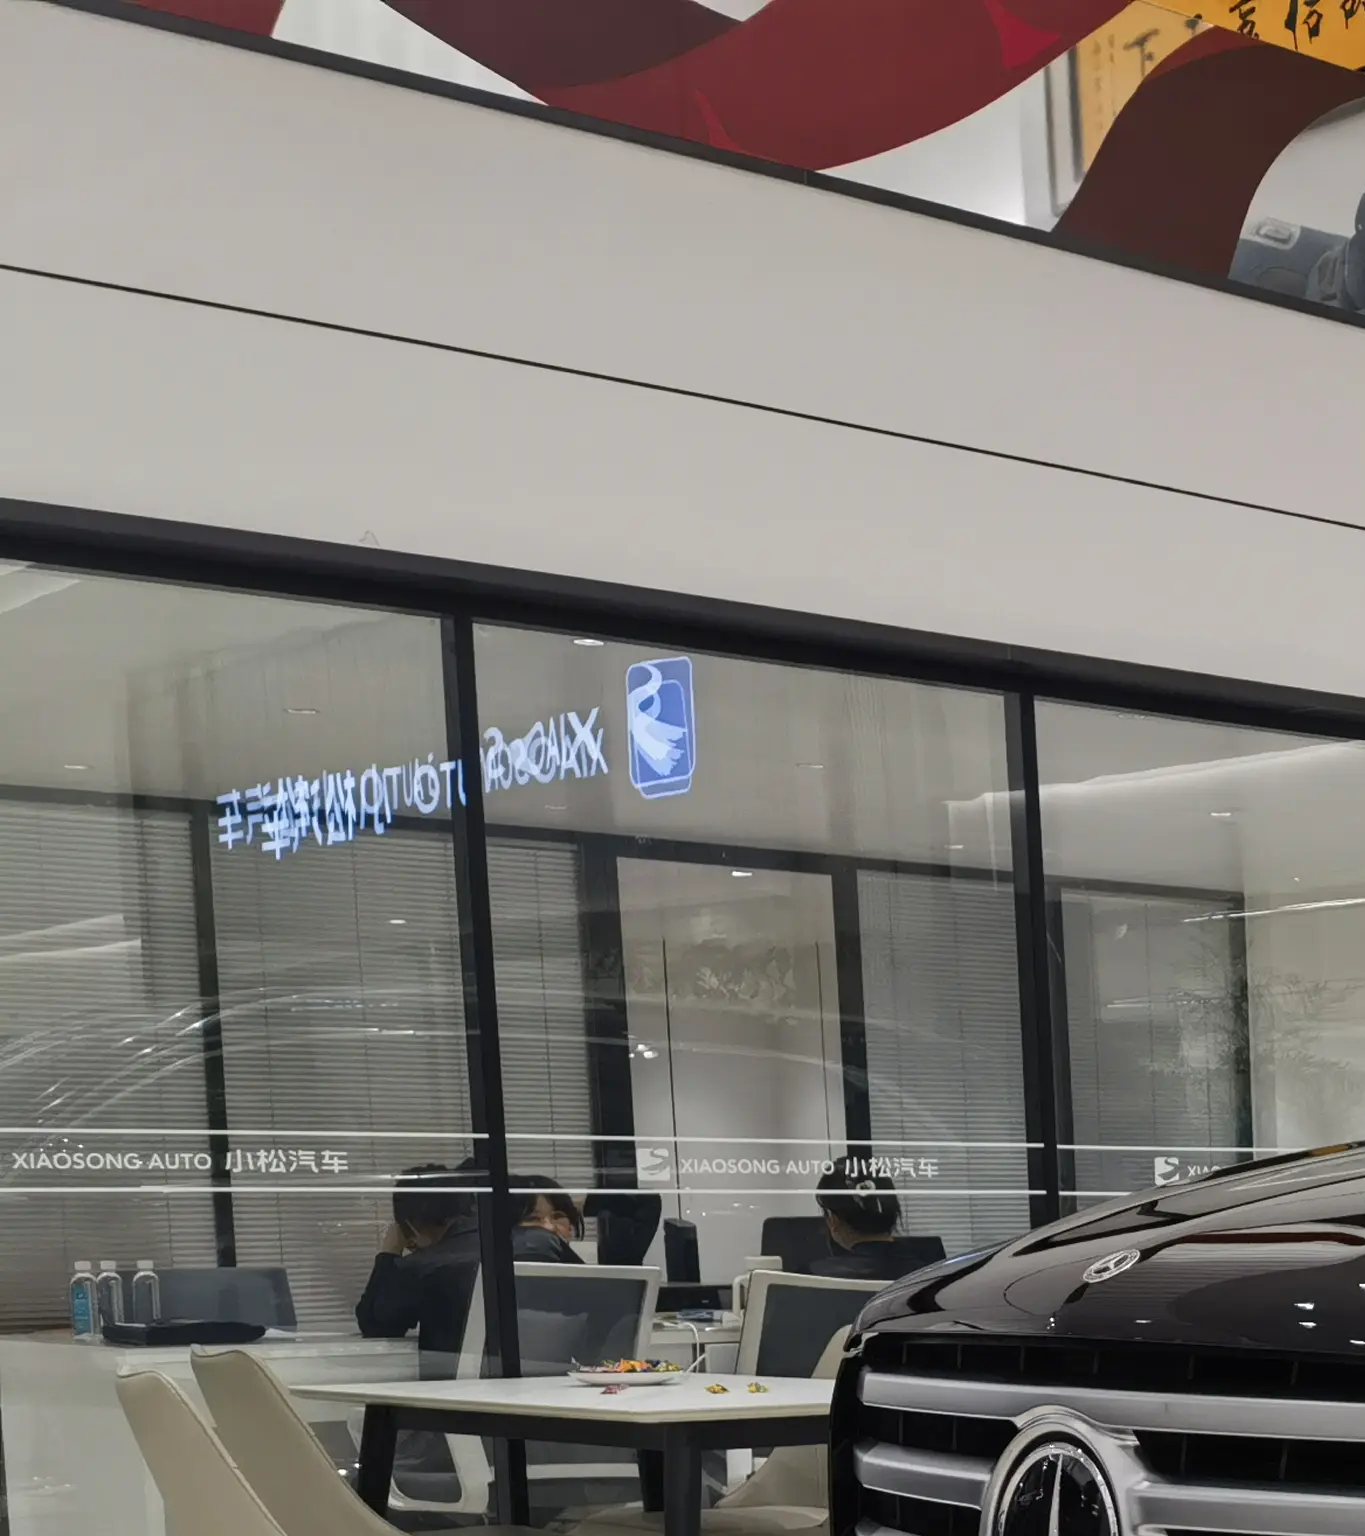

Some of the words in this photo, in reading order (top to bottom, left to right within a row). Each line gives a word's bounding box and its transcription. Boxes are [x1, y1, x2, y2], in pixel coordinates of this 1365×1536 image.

[12, 1152, 144, 1170] XIAOSONG
[148, 1152, 212, 1170] AUTO
[225, 1148, 349, 1173] 小松汽车
[680, 1158, 780, 1175] XIAOSONG
[786, 1159, 835, 1175] AUTO
[844, 1156, 939, 1178] 小松汽车
